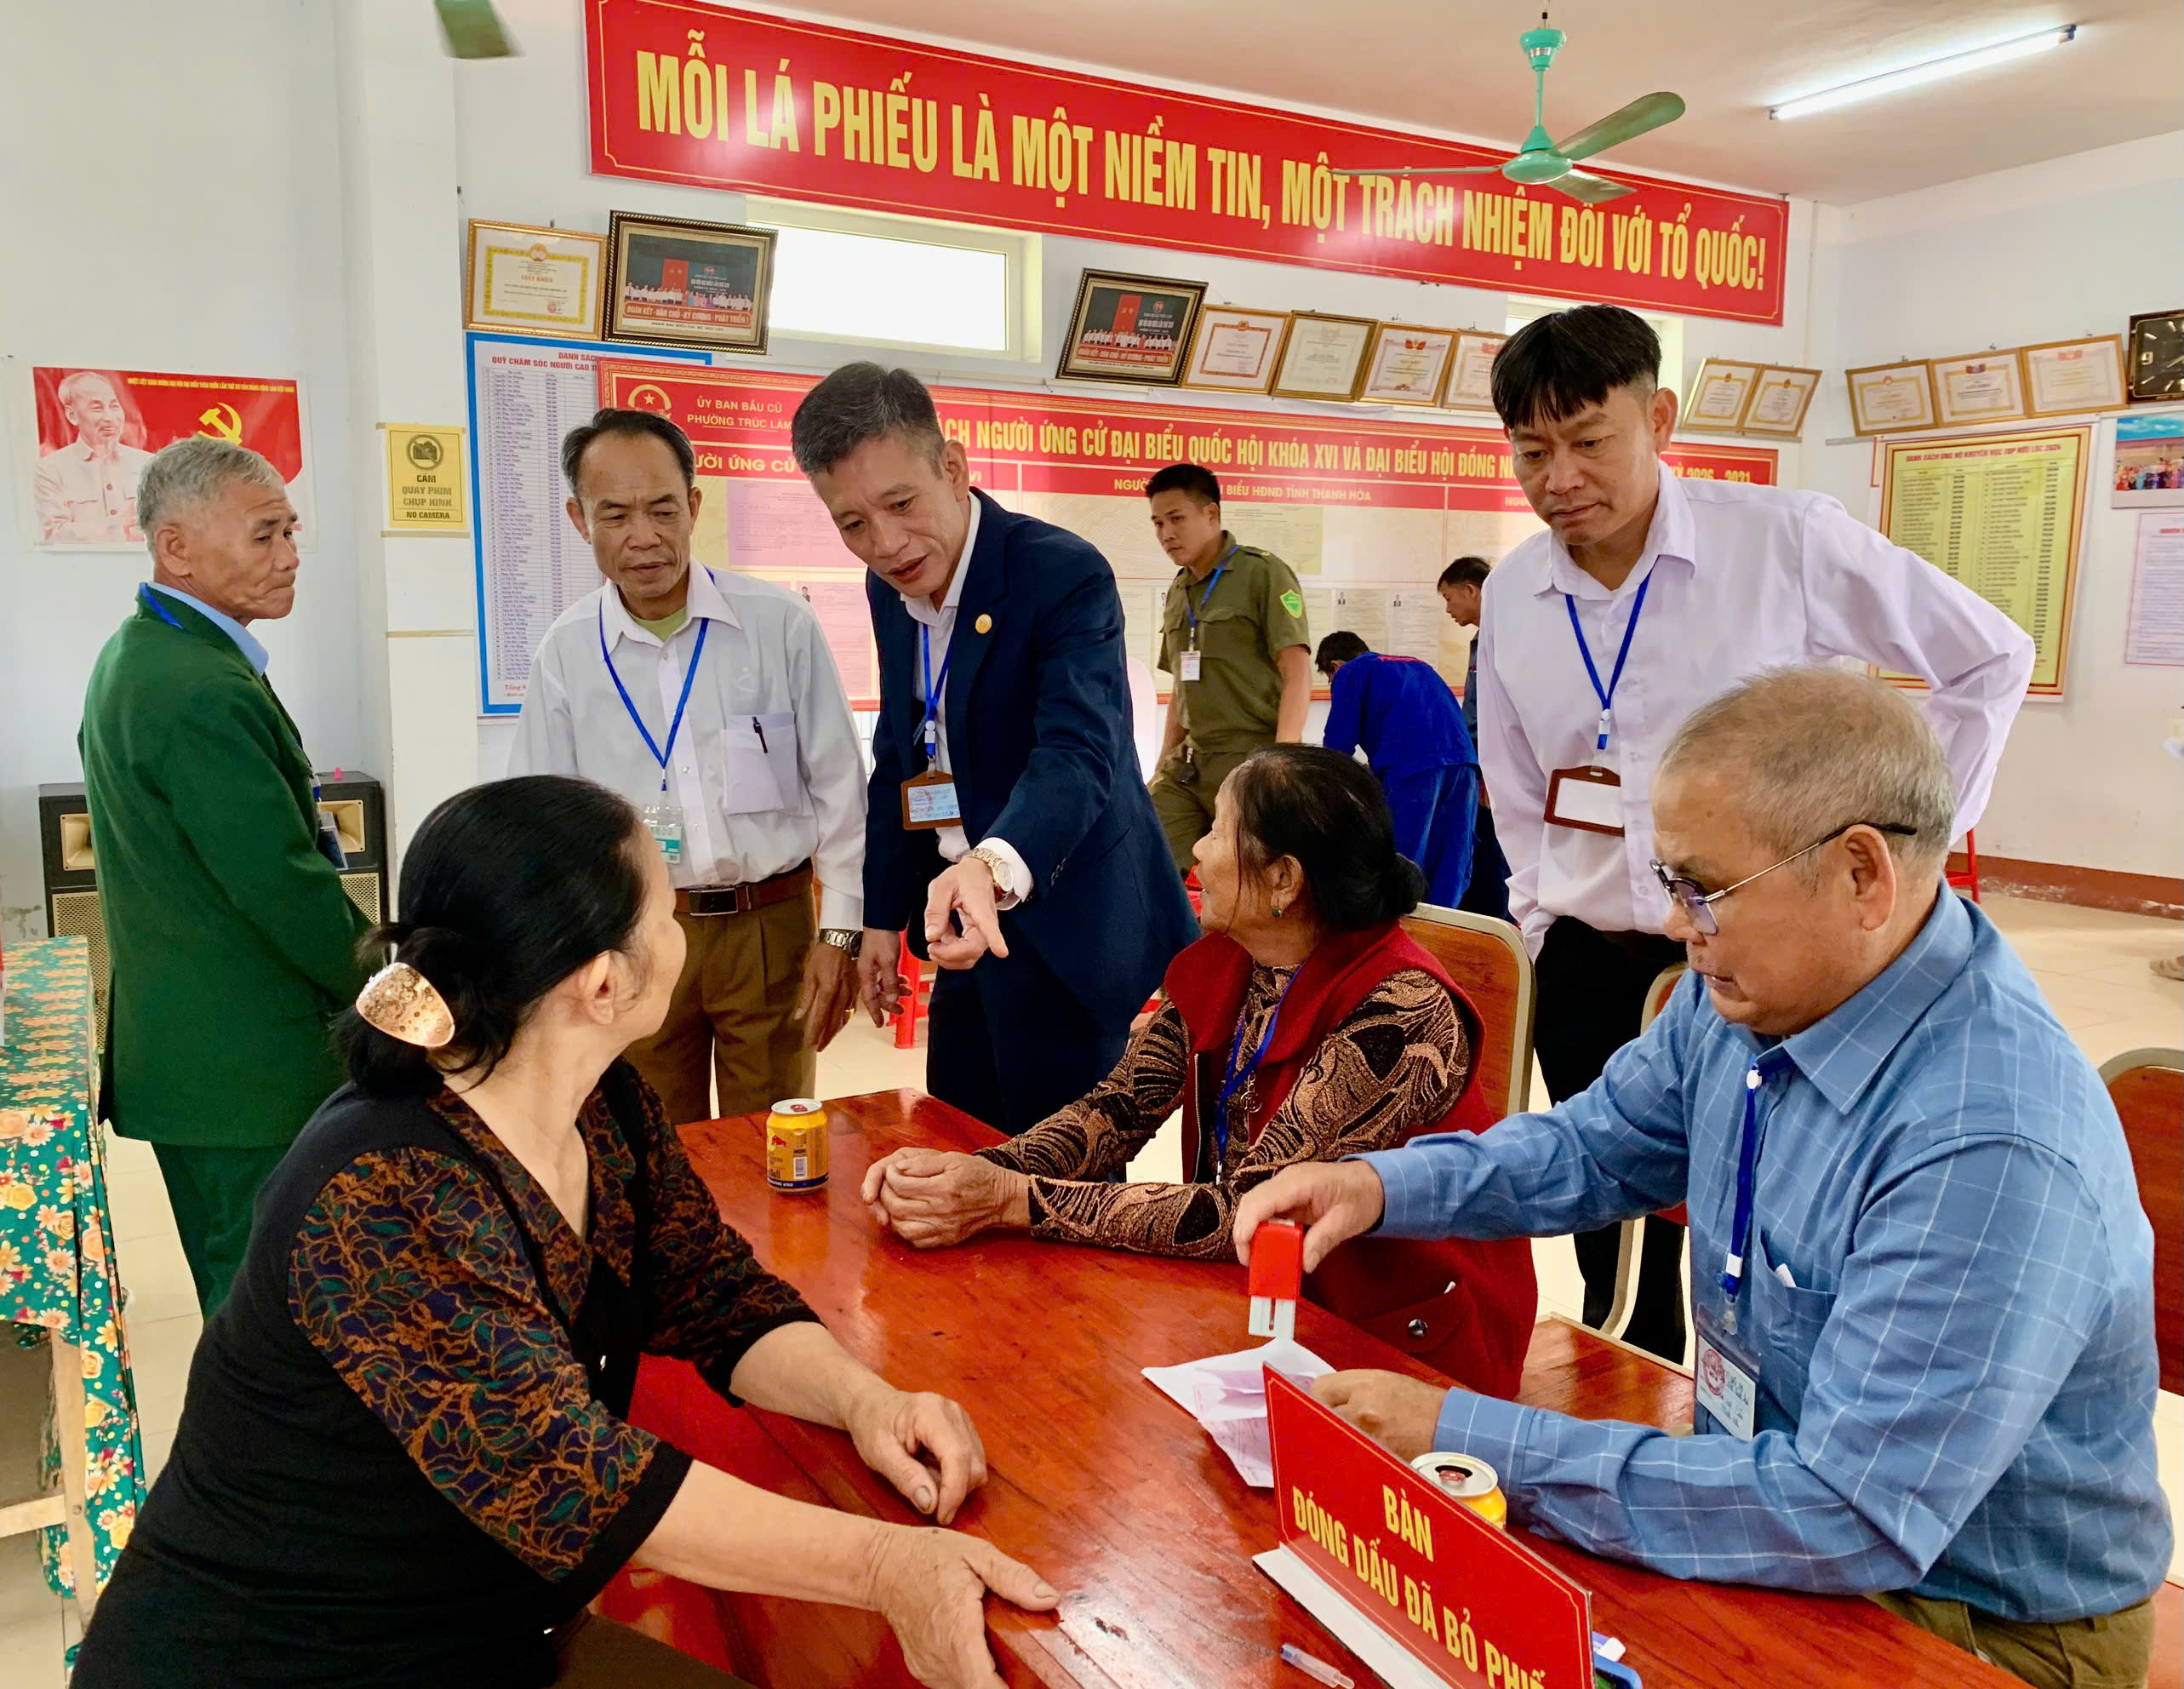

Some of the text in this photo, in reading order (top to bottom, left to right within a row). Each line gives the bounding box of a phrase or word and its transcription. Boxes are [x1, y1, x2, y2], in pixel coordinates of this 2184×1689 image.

[637, 29, 729, 141] MỖI
[745, 59, 800, 152] LÁ
[813, 71, 938, 175] PHIẾU
[952, 93, 1000, 183] LÀ
[1012, 106, 1094, 208] MỘT
[1105, 115, 1197, 210] NIỀM
[1208, 147, 1271, 230] TIN,
[1282, 152, 1350, 243] MỘT
[1358, 166, 1455, 247] TRÁCH
[1462, 186, 1553, 270] NHIỆM
[1612, 205, 1652, 275] VỚI
[1660, 203, 1691, 280] TỔ
[1695, 215, 1765, 291] QUỐC!
[697, 395, 712, 408] ỦY
[716, 399, 738, 409] BAN
[767, 401, 782, 413] CỬ
[687, 413, 792, 430] PHƯỜNG TRÚC LÂM
[976, 416, 1033, 452] NGƯỜI
[1040, 420, 1077, 455] ỨNG
[1083, 420, 1108, 456] CỬ
[1112, 429, 1140, 464] ĐẠI
[1145, 423, 1183, 461] BIỂU
[1188, 428, 1232, 466] QUỐC
[1237, 434, 1263, 471] HỘI
[1268, 437, 1309, 468] KHÓA
[1314, 444, 1339, 470] XVI
[1343, 440, 1362, 471] VÀ
[1366, 445, 1390, 478] ĐẠI
[1394, 440, 1426, 474] BIỂU
[1431, 447, 1455, 481] HỘI
[1458, 445, 1495, 478] ĐỒNG
[695, 453, 797, 472] ƯỜI ỨNG CỬ
[402, 486, 452, 495] QUAY PHIM
[1226, 479, 1249, 495] BIỂU
[1252, 485, 1283, 497] HĐND
[1312, 488, 1346, 500] THANH
[1348, 488, 1372, 501] HÓA
[1383, 1485, 1434, 1562] BÀN
[1293, 1486, 1350, 1567] ĐÓNG
[1353, 1533, 1399, 1606] DẤU
[1404, 1574, 1439, 1642] ĐÃ
[1444, 1606, 1478, 1673] BỎ
